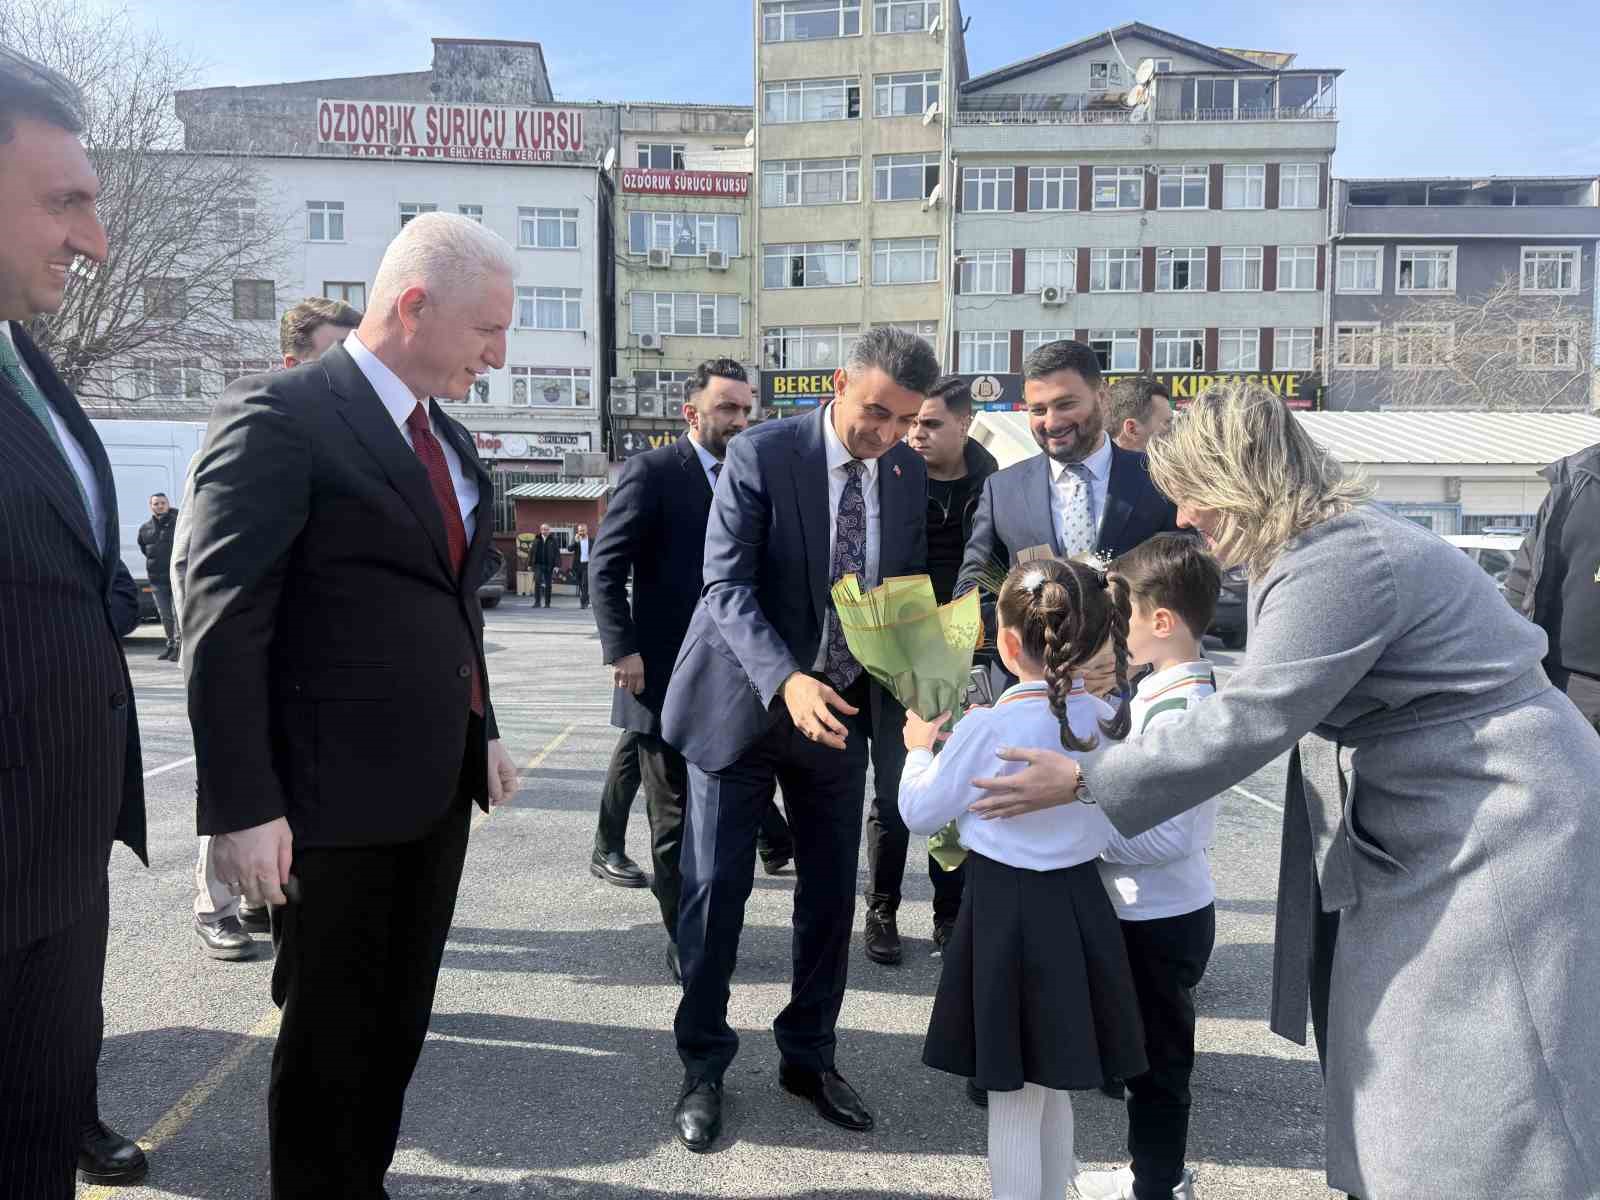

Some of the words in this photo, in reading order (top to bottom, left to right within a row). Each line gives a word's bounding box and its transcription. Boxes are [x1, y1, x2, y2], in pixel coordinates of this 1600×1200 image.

[426, 102, 507, 147] SÜRÜCÜ
[515, 110, 582, 151] KURSU
[715, 177, 747, 193] KURSU
[773, 375, 834, 393] BEREK
[1172, 375, 1300, 398] KIRİYE
[473, 432, 502, 452] hop
